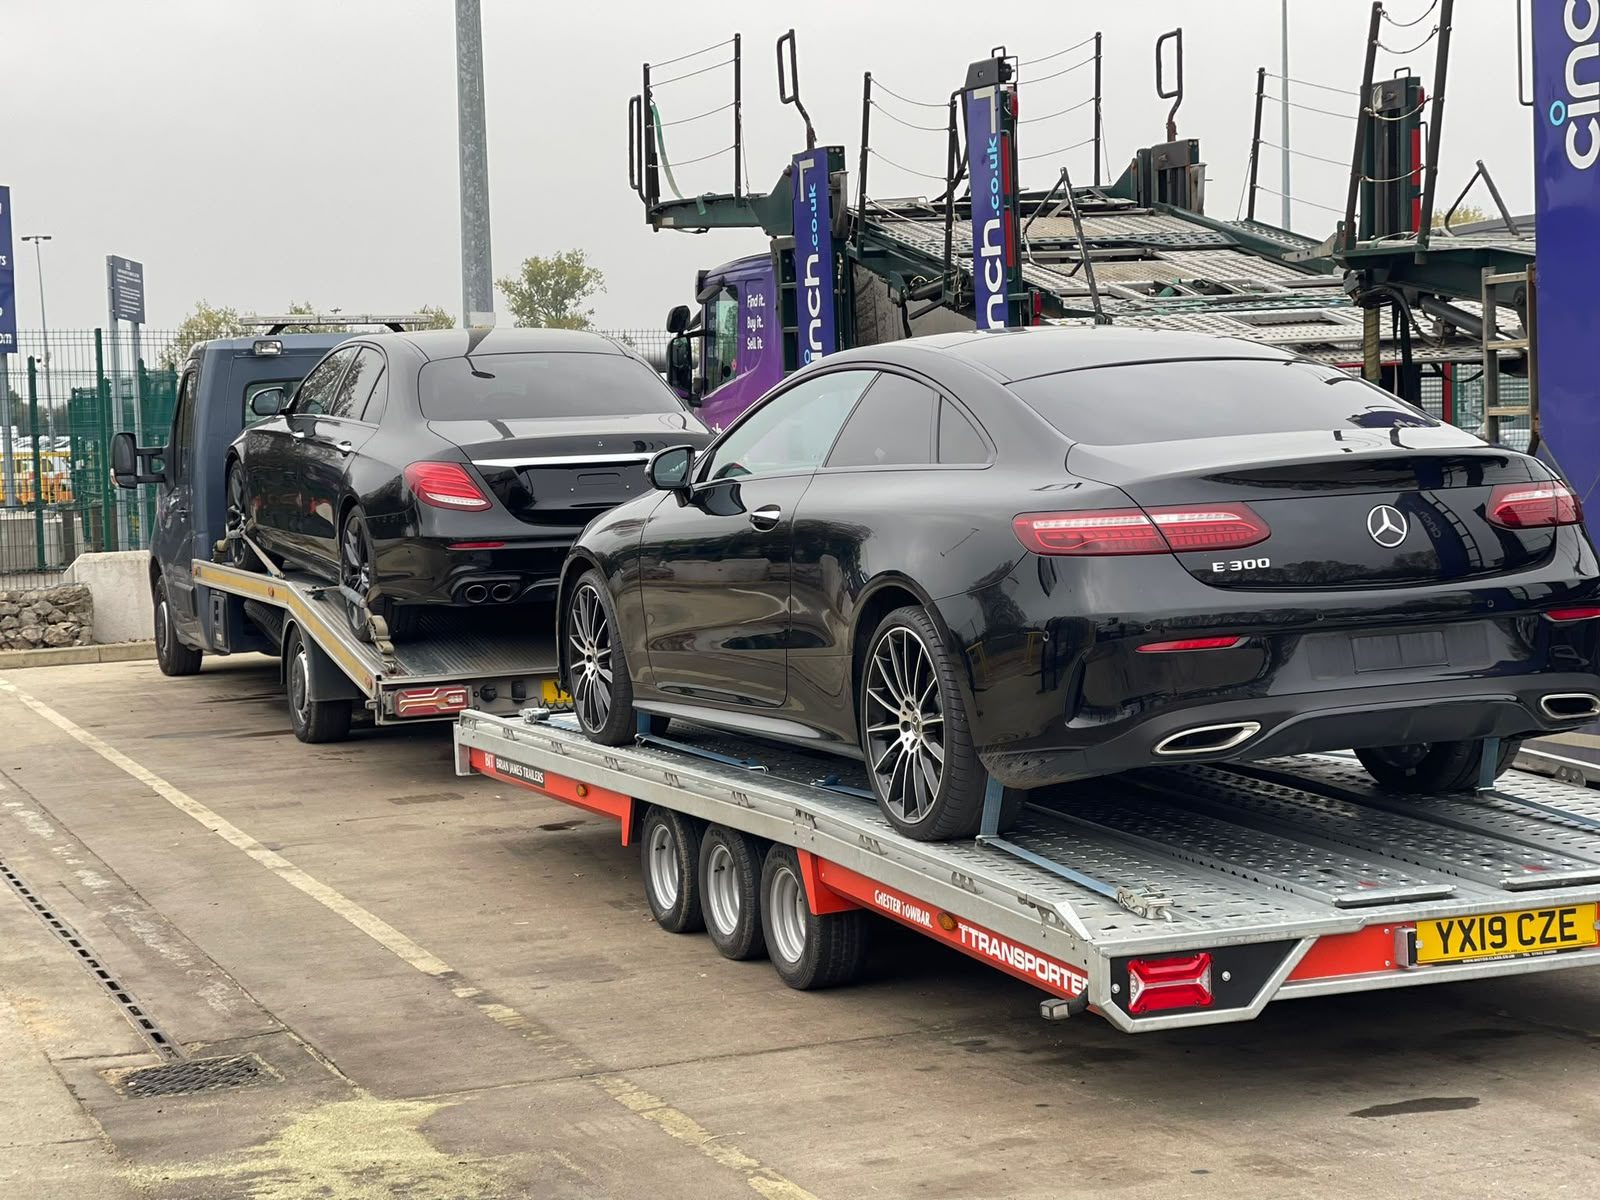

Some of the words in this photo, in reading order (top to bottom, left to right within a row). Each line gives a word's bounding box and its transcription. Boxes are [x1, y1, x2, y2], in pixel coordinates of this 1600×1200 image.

[1550, 0, 1600, 169] cinc
[747, 294, 758, 308] Find
[747, 316, 757, 332] Buy
[747, 337, 756, 350] Sell
[1212, 562, 1225, 573] E
[1230, 558, 1270, 572] 300
[496, 758, 509, 771] BRIAN
[509, 762, 522, 777] JAMES
[523, 767, 544, 784] TRAILERS
[874, 889, 901, 914] CHESTER
[1436, 916, 1508, 954] YX19
[1517, 908, 1577, 946] CZE
